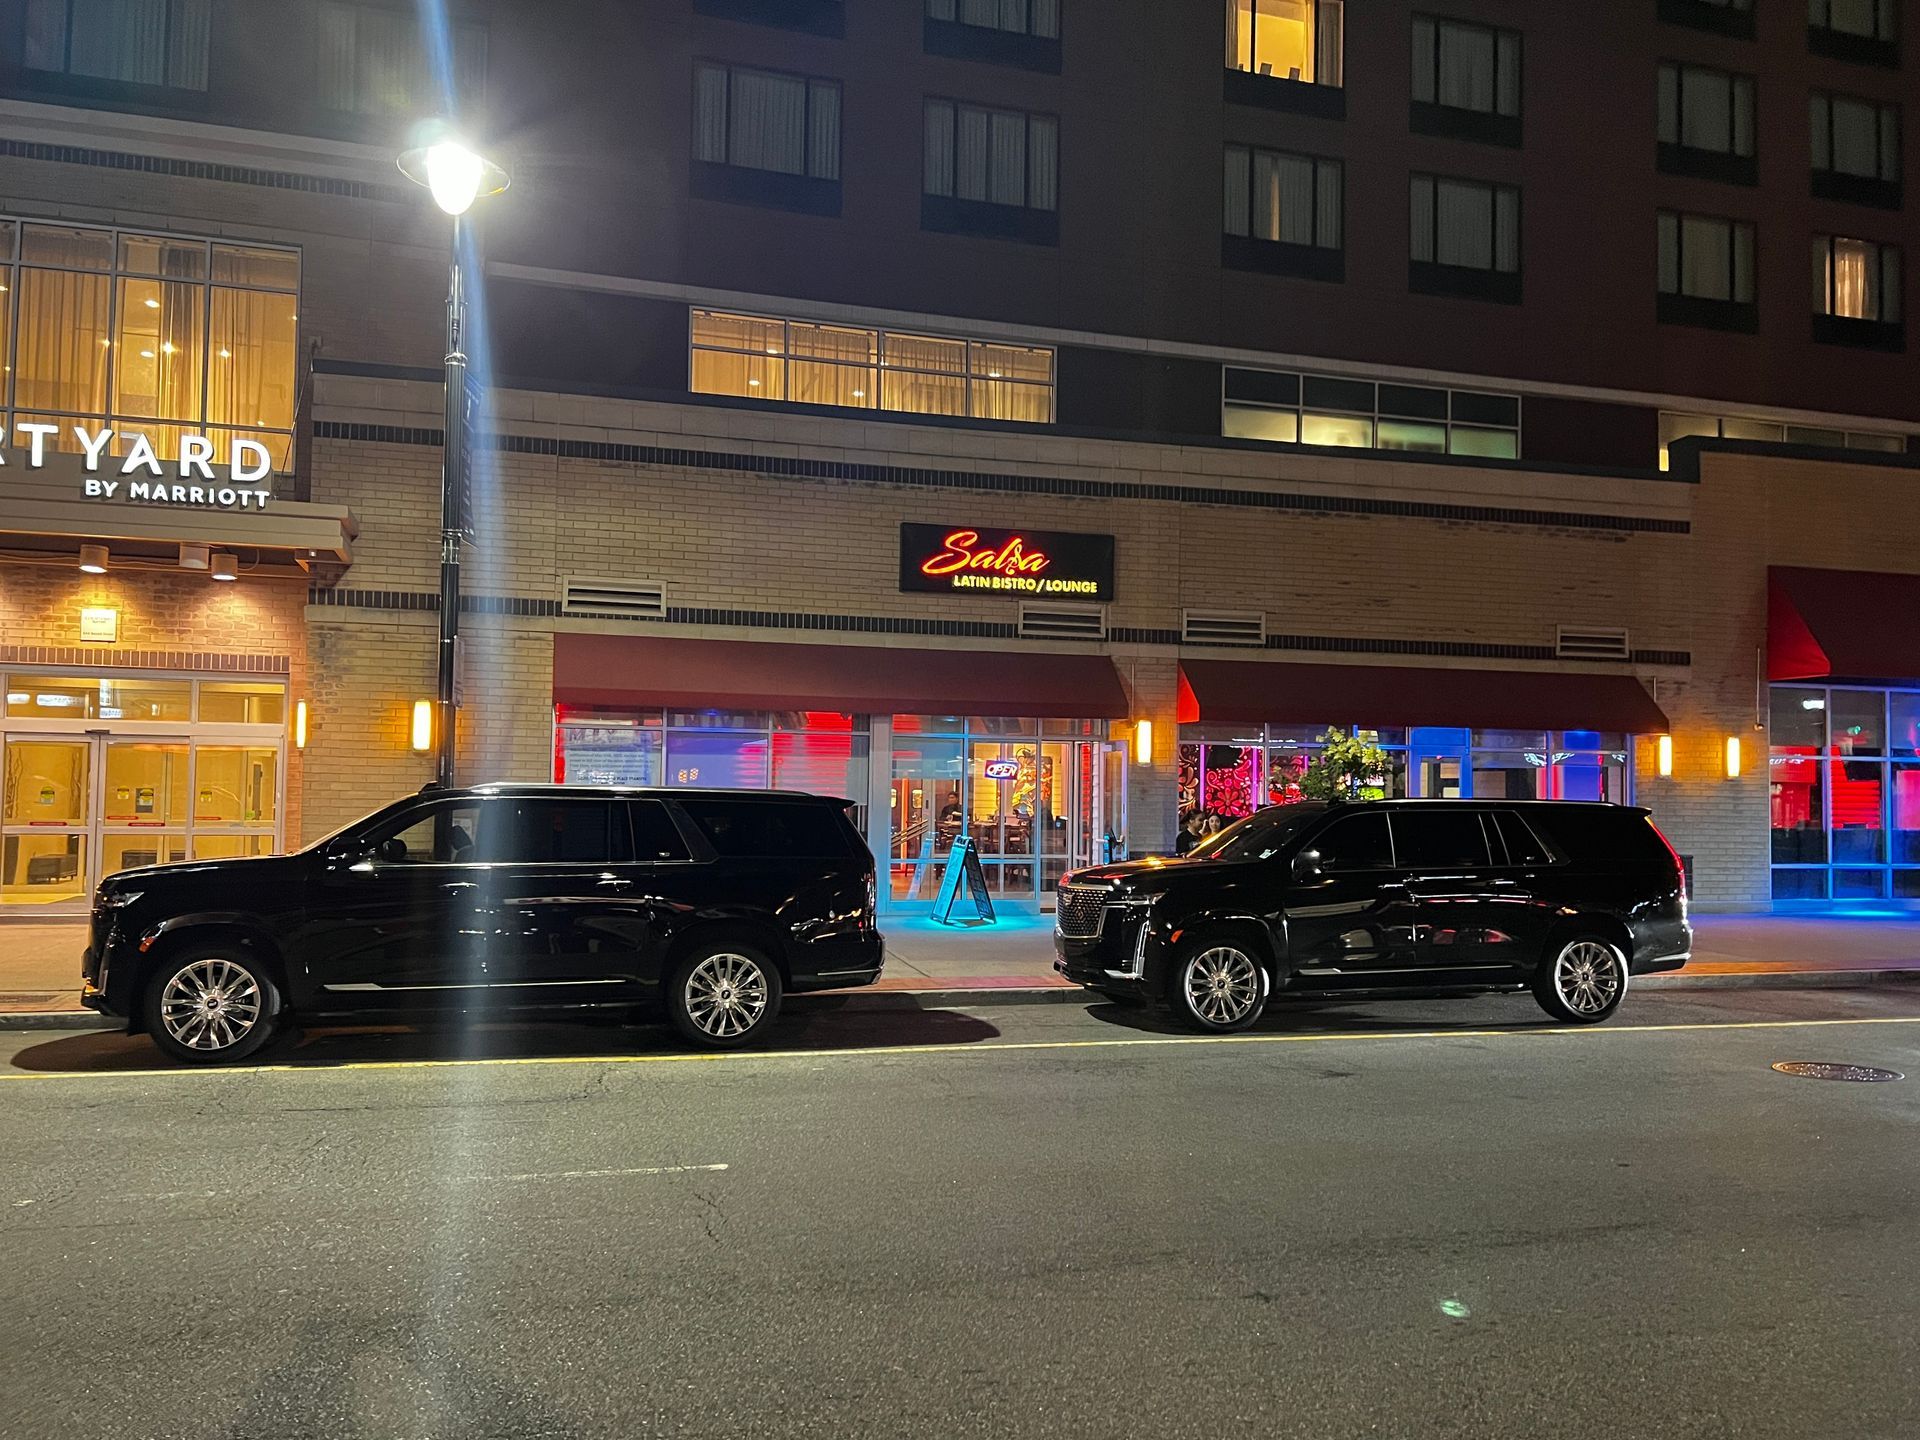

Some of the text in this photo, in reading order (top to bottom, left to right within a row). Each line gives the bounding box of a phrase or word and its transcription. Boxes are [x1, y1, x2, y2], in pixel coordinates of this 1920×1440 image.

[0, 423, 271, 482] TYARD
[85, 479, 270, 508] BY MARRIOTT
[922, 531, 1050, 575] Salsa
[953, 575, 990, 587] LATIN
[987, 764, 1017, 777] OPEN
